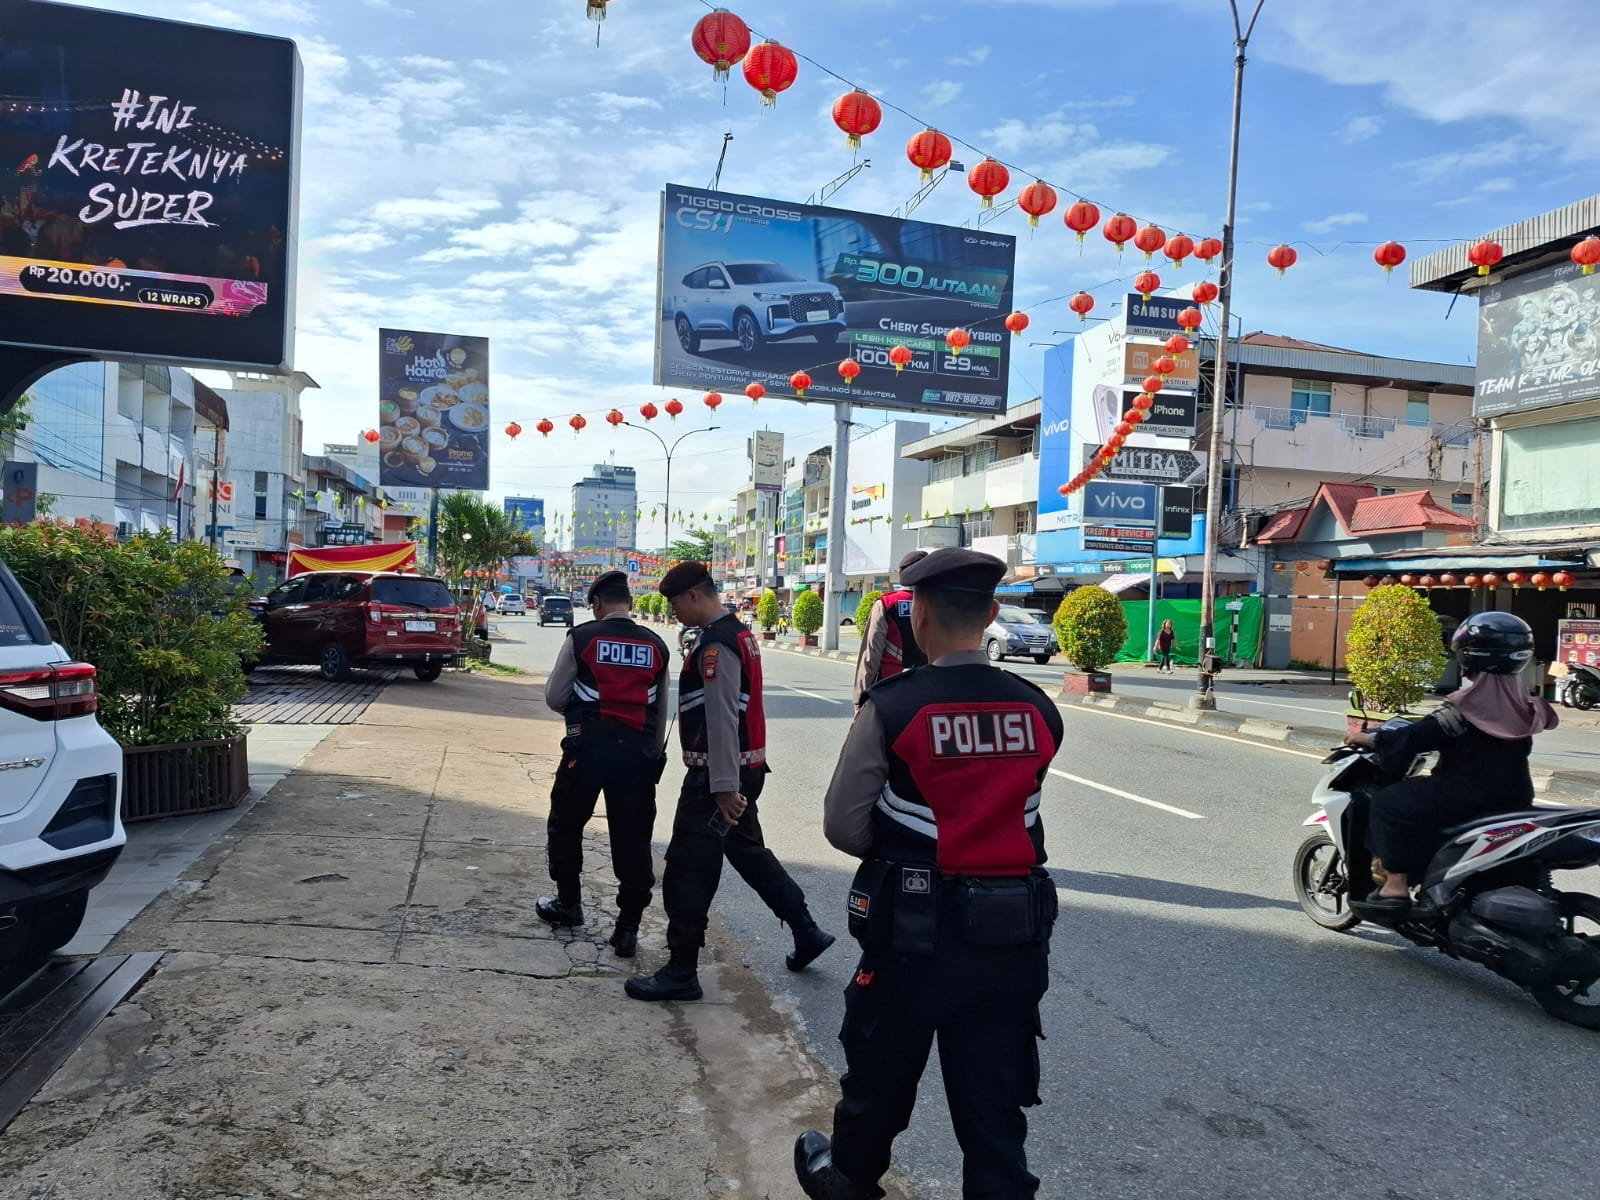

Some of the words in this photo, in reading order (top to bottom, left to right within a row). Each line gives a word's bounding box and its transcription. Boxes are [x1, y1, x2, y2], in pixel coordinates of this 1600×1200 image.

[111, 88, 197, 133] #INI
[48, 134, 248, 183] KRETEKNYA
[79, 182, 217, 228] SUPER
[677, 194, 734, 211] TIGGO
[736, 204, 802, 221] CROSS
[676, 207, 734, 233] CSH
[980, 239, 1010, 248] CHERY
[29, 265, 45, 278] Rp
[47, 267, 131, 292] 20.000,-
[856, 259, 924, 288] 300
[921, 277, 996, 298] JUTAAN
[146, 290, 159, 302] 12
[161, 292, 201, 306] WRAPS
[1132, 303, 1181, 319] SAMSU
[879, 318, 919, 334] CHERY
[920, 322, 950, 337] SUPE
[1133, 327, 1152, 335] MITRA
[1154, 329, 1170, 337] MEGA
[855, 333, 884, 343] LEBIH
[886, 336, 932, 349] KENCANG
[944, 355, 971, 371] 29
[707, 366, 750, 377] TESTDRIVE
[752, 371, 791, 381] SEKARAN
[699, 372, 747, 383] PONTIANAK
[809, 385, 850, 394] MOBILINDO
[851, 388, 896, 399] SEJAHTERA
[1479, 375, 1515, 396] TEAM
[1154, 404, 1185, 416] iPhone
[1043, 418, 1069, 437] vivo
[1111, 451, 1179, 471] MITRA
[1094, 491, 1146, 509] vivo
[1057, 513, 1080, 526] MITR
[1085, 527, 1108, 537] KREDIT
[1118, 529, 1145, 538] SERVICE
[1130, 562, 1150, 570] oppo
[599, 642, 652, 667] POLISI
[931, 712, 1035, 755] POLISI
